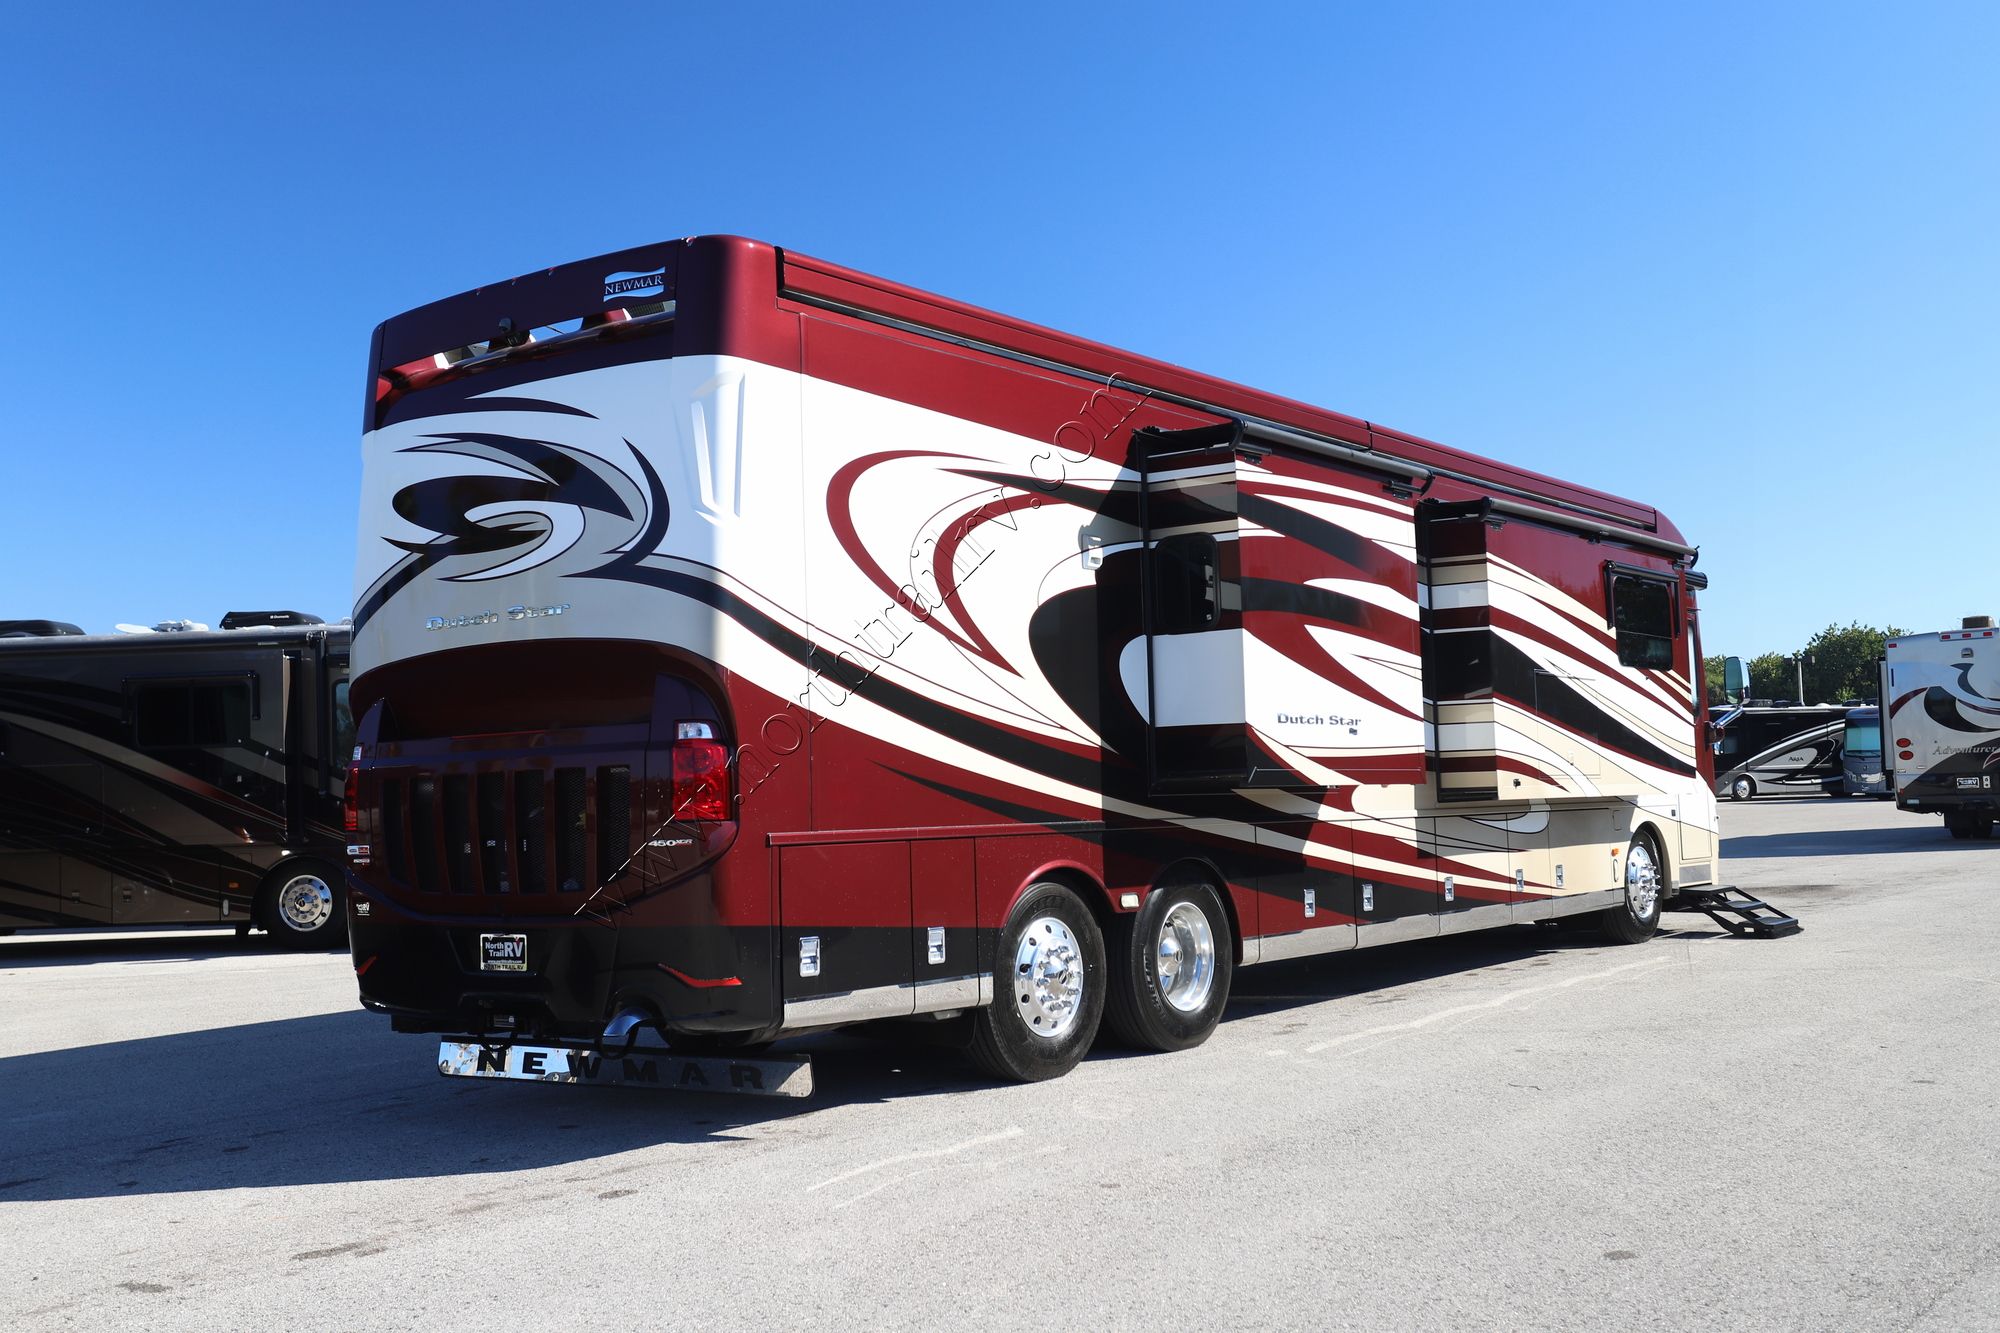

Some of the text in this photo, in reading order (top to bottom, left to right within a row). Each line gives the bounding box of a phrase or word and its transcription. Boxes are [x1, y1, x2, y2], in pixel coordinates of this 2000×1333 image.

[604, 275, 664, 295] NEWMAR
[425, 603, 571, 631] Dutch Star
[1277, 713, 1361, 726] Dutch Star
[485, 941, 504, 949] North
[504, 941, 523, 957] RV
[476, 1048, 765, 1090] NEWMAR
